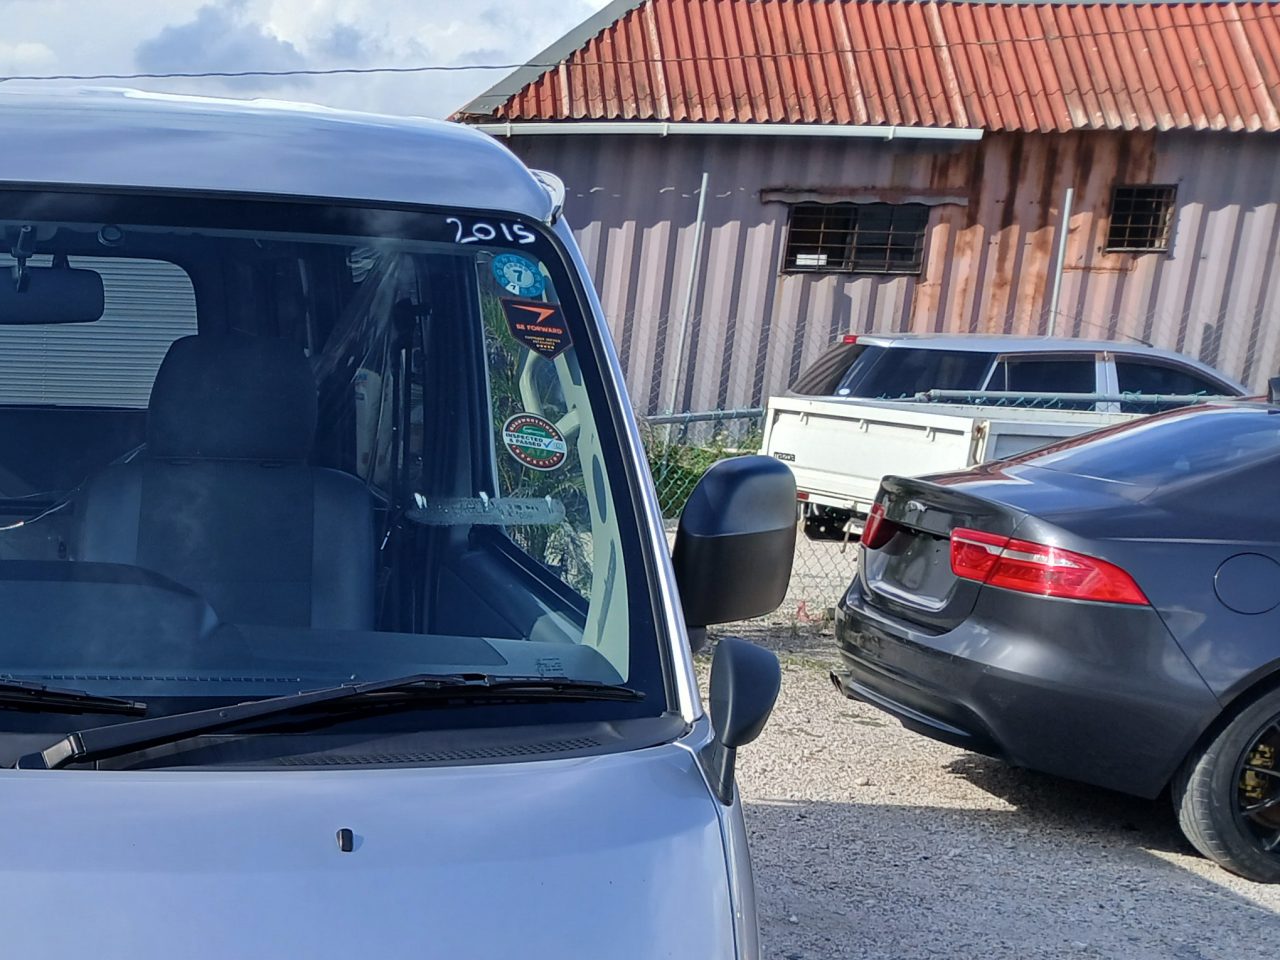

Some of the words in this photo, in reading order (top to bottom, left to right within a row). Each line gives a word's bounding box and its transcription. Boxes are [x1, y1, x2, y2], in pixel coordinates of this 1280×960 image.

[445, 217, 536, 244] 2015
[512, 269, 523, 283] 7
[526, 324, 563, 335] FORWARD
[505, 432, 544, 443] INSPECTED
[515, 439, 542, 448] PASSED
